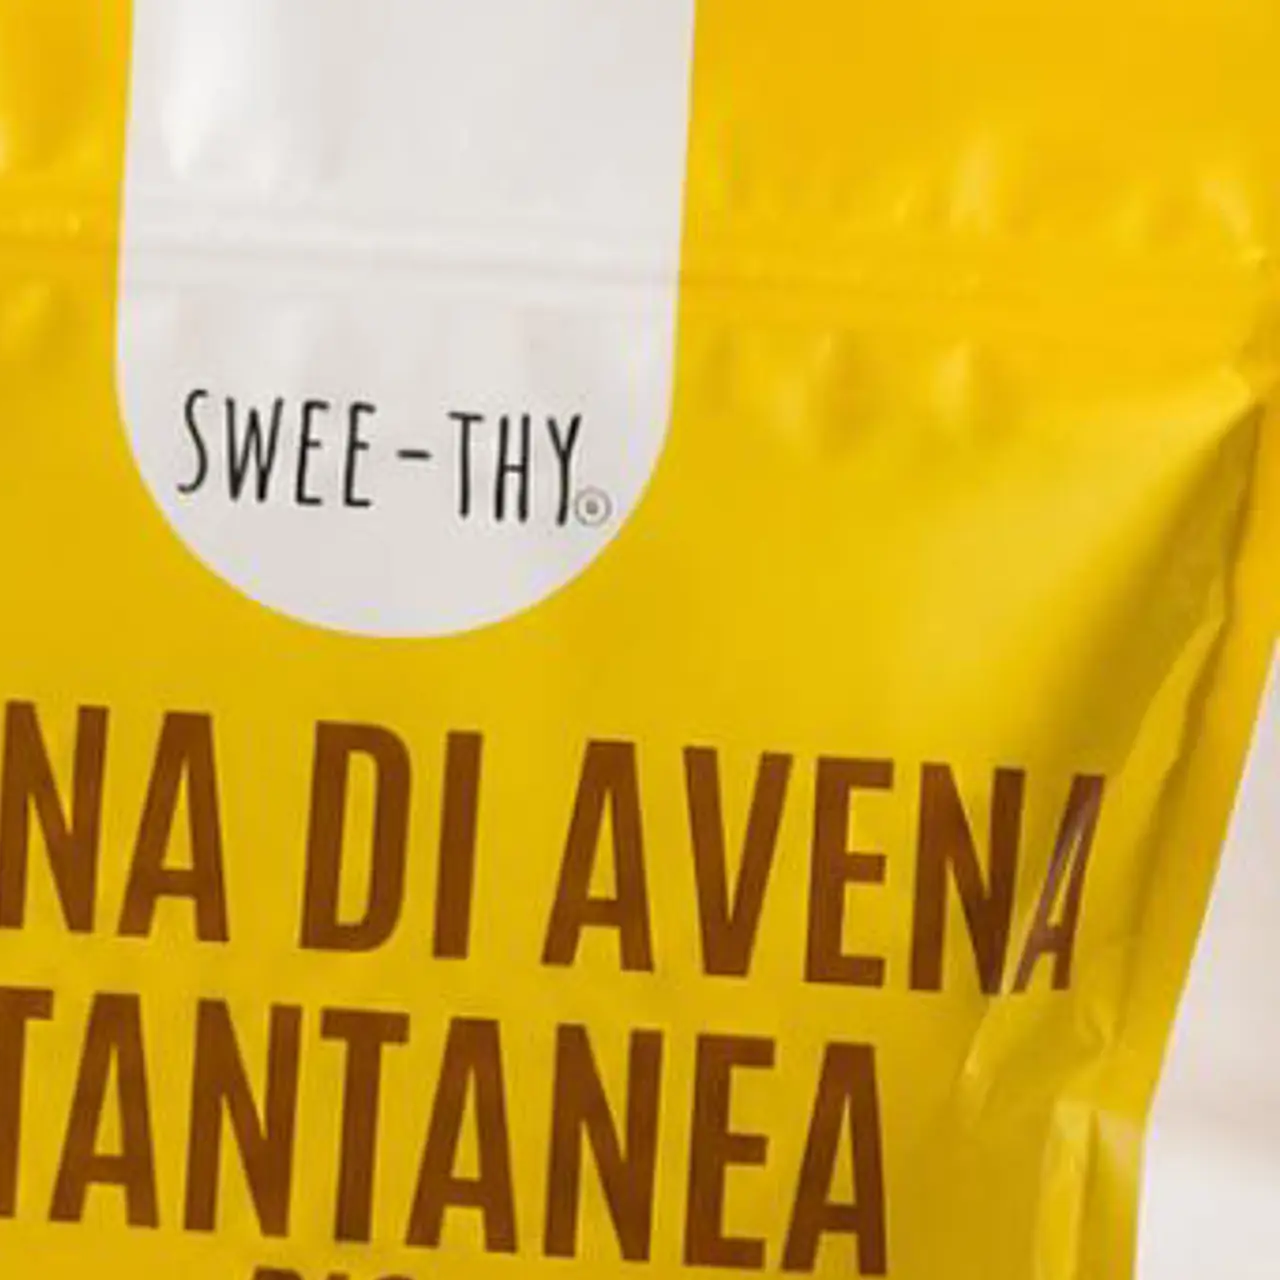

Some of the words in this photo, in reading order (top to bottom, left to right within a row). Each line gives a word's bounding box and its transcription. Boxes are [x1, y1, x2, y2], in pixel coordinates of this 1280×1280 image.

[177, 389, 583, 526] SWEE-THY
[299, 720, 484, 961] DI
[541, 738, 1106, 996] AVENA
